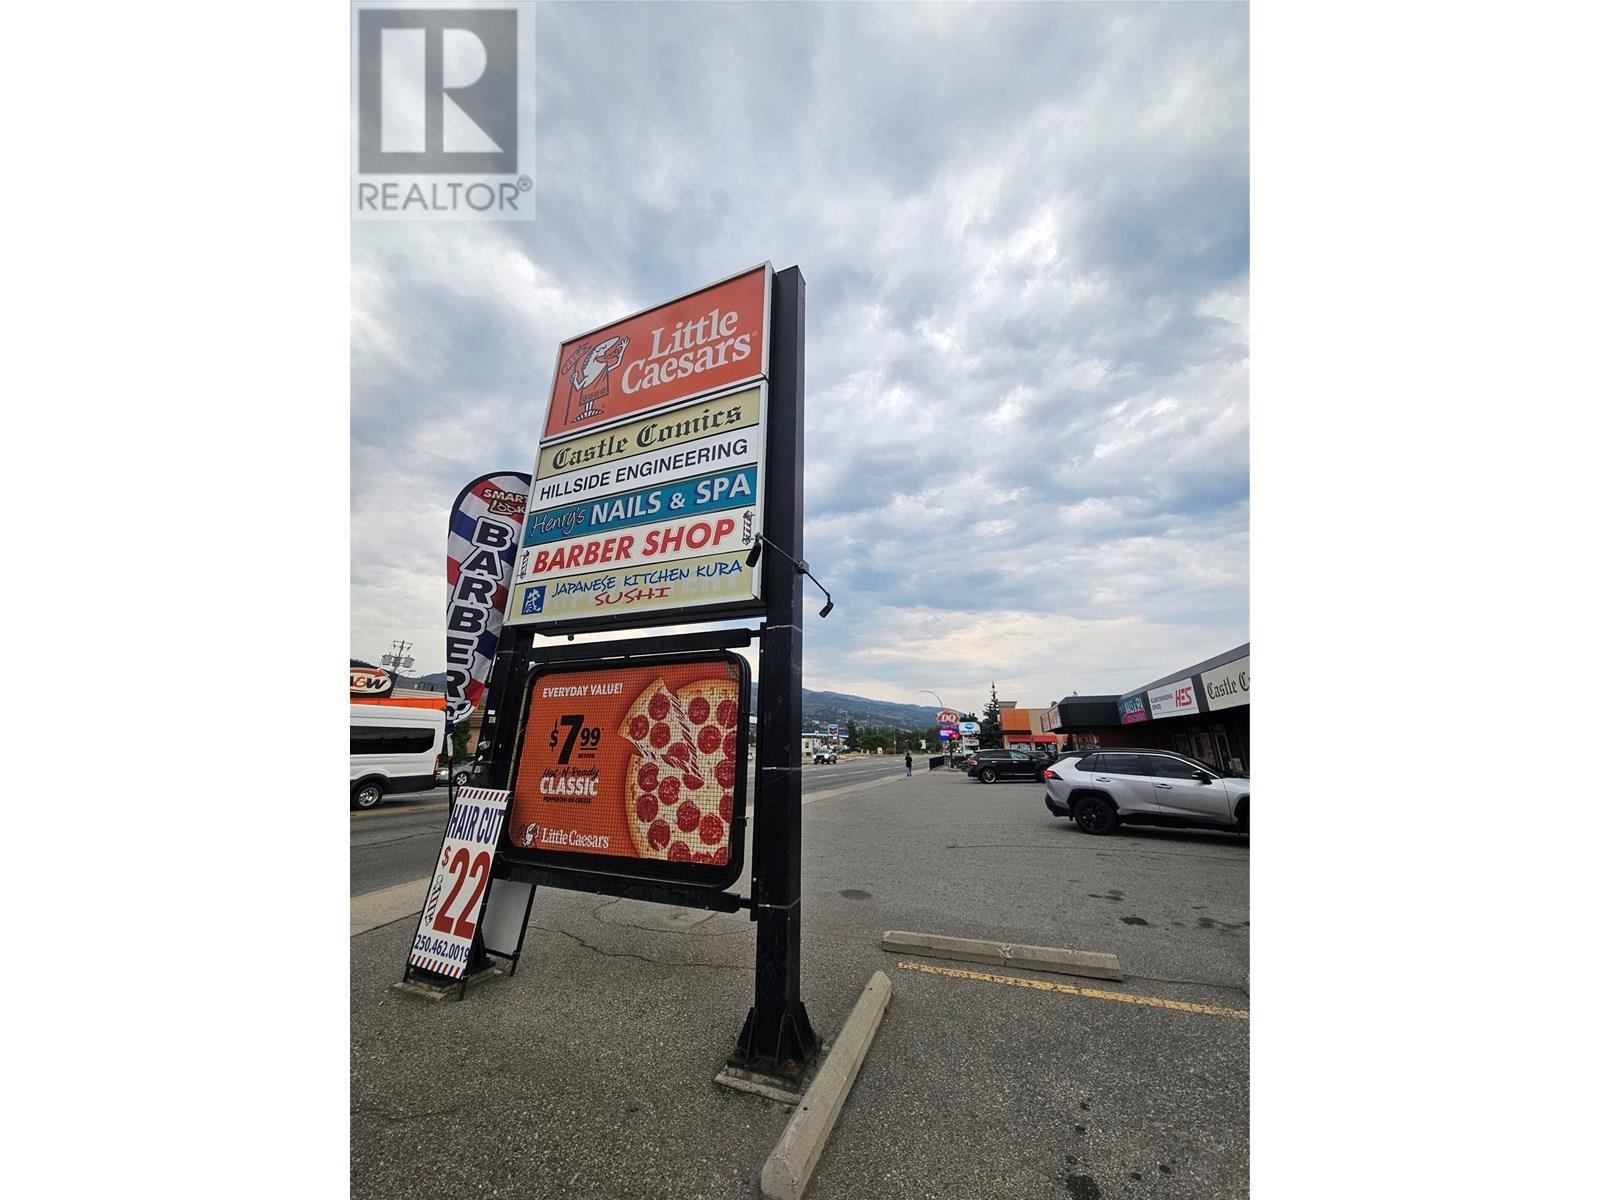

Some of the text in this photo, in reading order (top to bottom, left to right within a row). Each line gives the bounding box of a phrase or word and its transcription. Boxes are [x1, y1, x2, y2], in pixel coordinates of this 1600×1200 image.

[647, 308, 738, 361] Little
[621, 331, 752, 395] Caesars
[552, 405, 742, 470] Castle Comics
[540, 438, 748, 500] HILLSIDE ENGINEERING
[483, 489, 528, 503] SMAR
[530, 473, 751, 537] Henry's NAILS & SPA
[532, 518, 735, 574] BARBER SHOP
[551, 559, 743, 598] JAPANESE KITCHEN KURA
[594, 587, 671, 607] SUSHI
[542, 682, 623, 698] EVERYDAY VALUE!
[1175, 686, 1192, 707] HES
[1207, 677, 1237, 700] Castle
[941, 713, 957, 723] DQ
[539, 777, 599, 796] CLASSIC
[447, 804, 505, 845] HAIR CUT
[541, 827, 610, 848] Little Caesars
[414, 934, 470, 964] 250.462.0019
